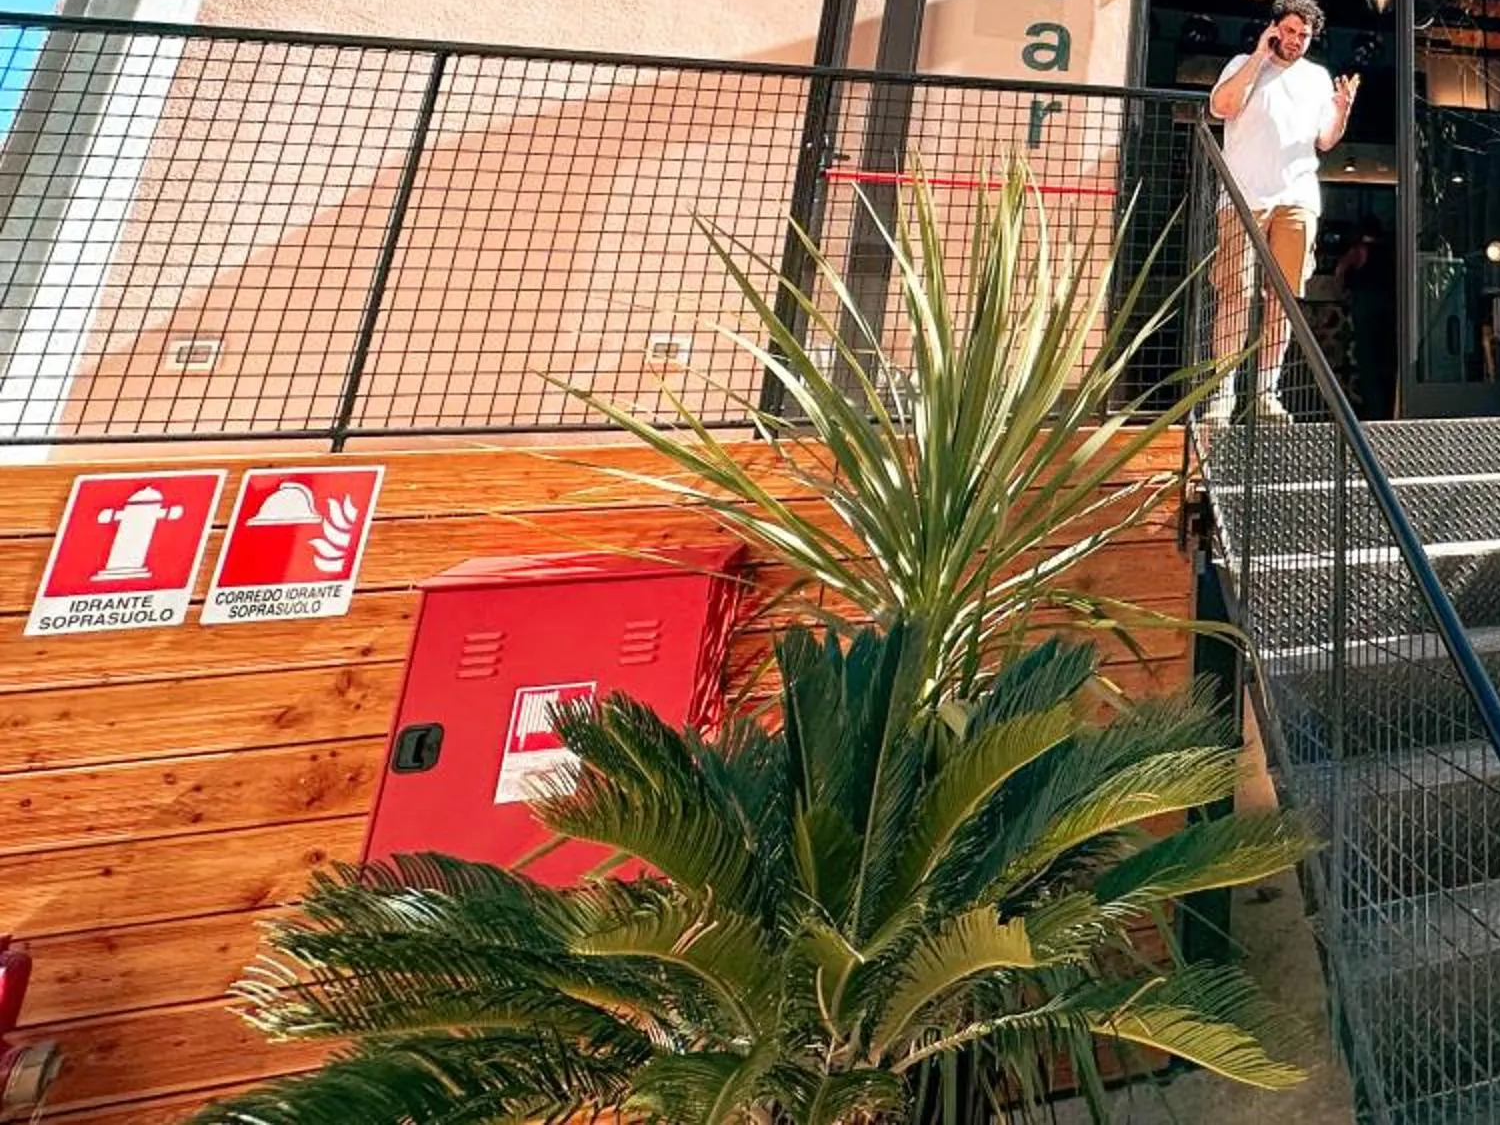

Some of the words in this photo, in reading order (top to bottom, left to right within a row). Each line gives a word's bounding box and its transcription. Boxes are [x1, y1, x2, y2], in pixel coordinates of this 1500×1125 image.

[69, 595, 154, 613] IDRANTE
[215, 588, 283, 606] CORREDO
[284, 584, 343, 601] IDRANTE
[39, 609, 174, 630] SOPRASUOLO
[228, 600, 321, 619] SOPRASUOLO
